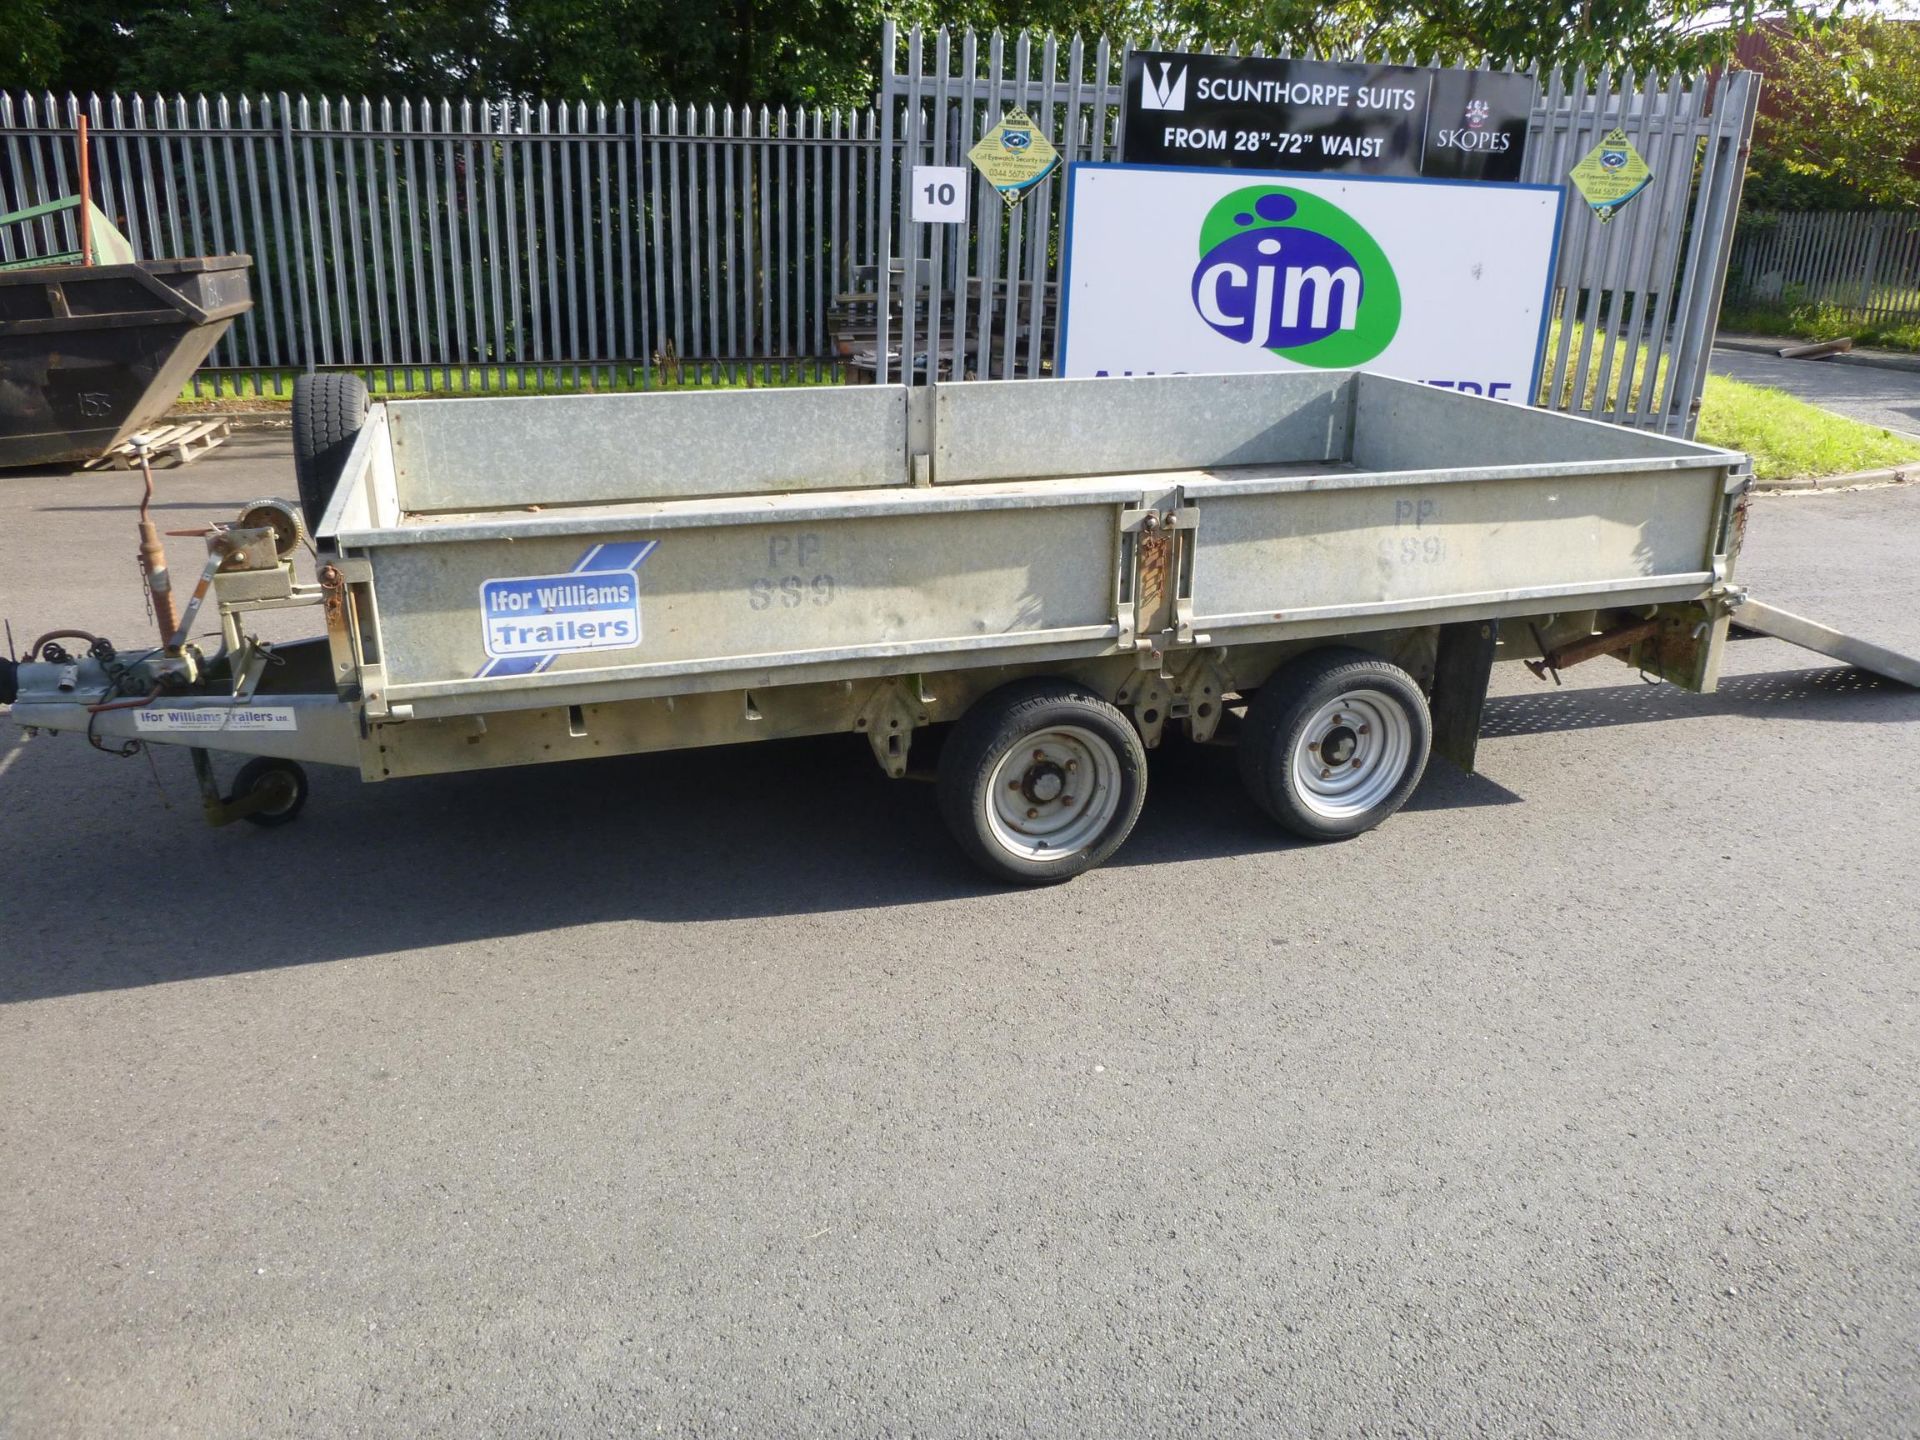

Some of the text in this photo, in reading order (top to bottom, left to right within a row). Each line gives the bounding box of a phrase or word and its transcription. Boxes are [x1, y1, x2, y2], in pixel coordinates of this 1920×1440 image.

[1197, 78, 1415, 111] SCUNTHORPE SUITS
[1164, 127, 1227, 150] FROM
[1321, 136, 1384, 157] WAIST
[1437, 128, 1511, 152] SKOPES
[924, 183, 955, 205] 10
[1199, 238, 1361, 348] cjm
[491, 584, 630, 612] Ifor Williams
[496, 620, 630, 646] Trailers
[141, 712, 163, 722] Ifor
[167, 711, 222, 722] Williams
[224, 711, 273, 722] Trailers
